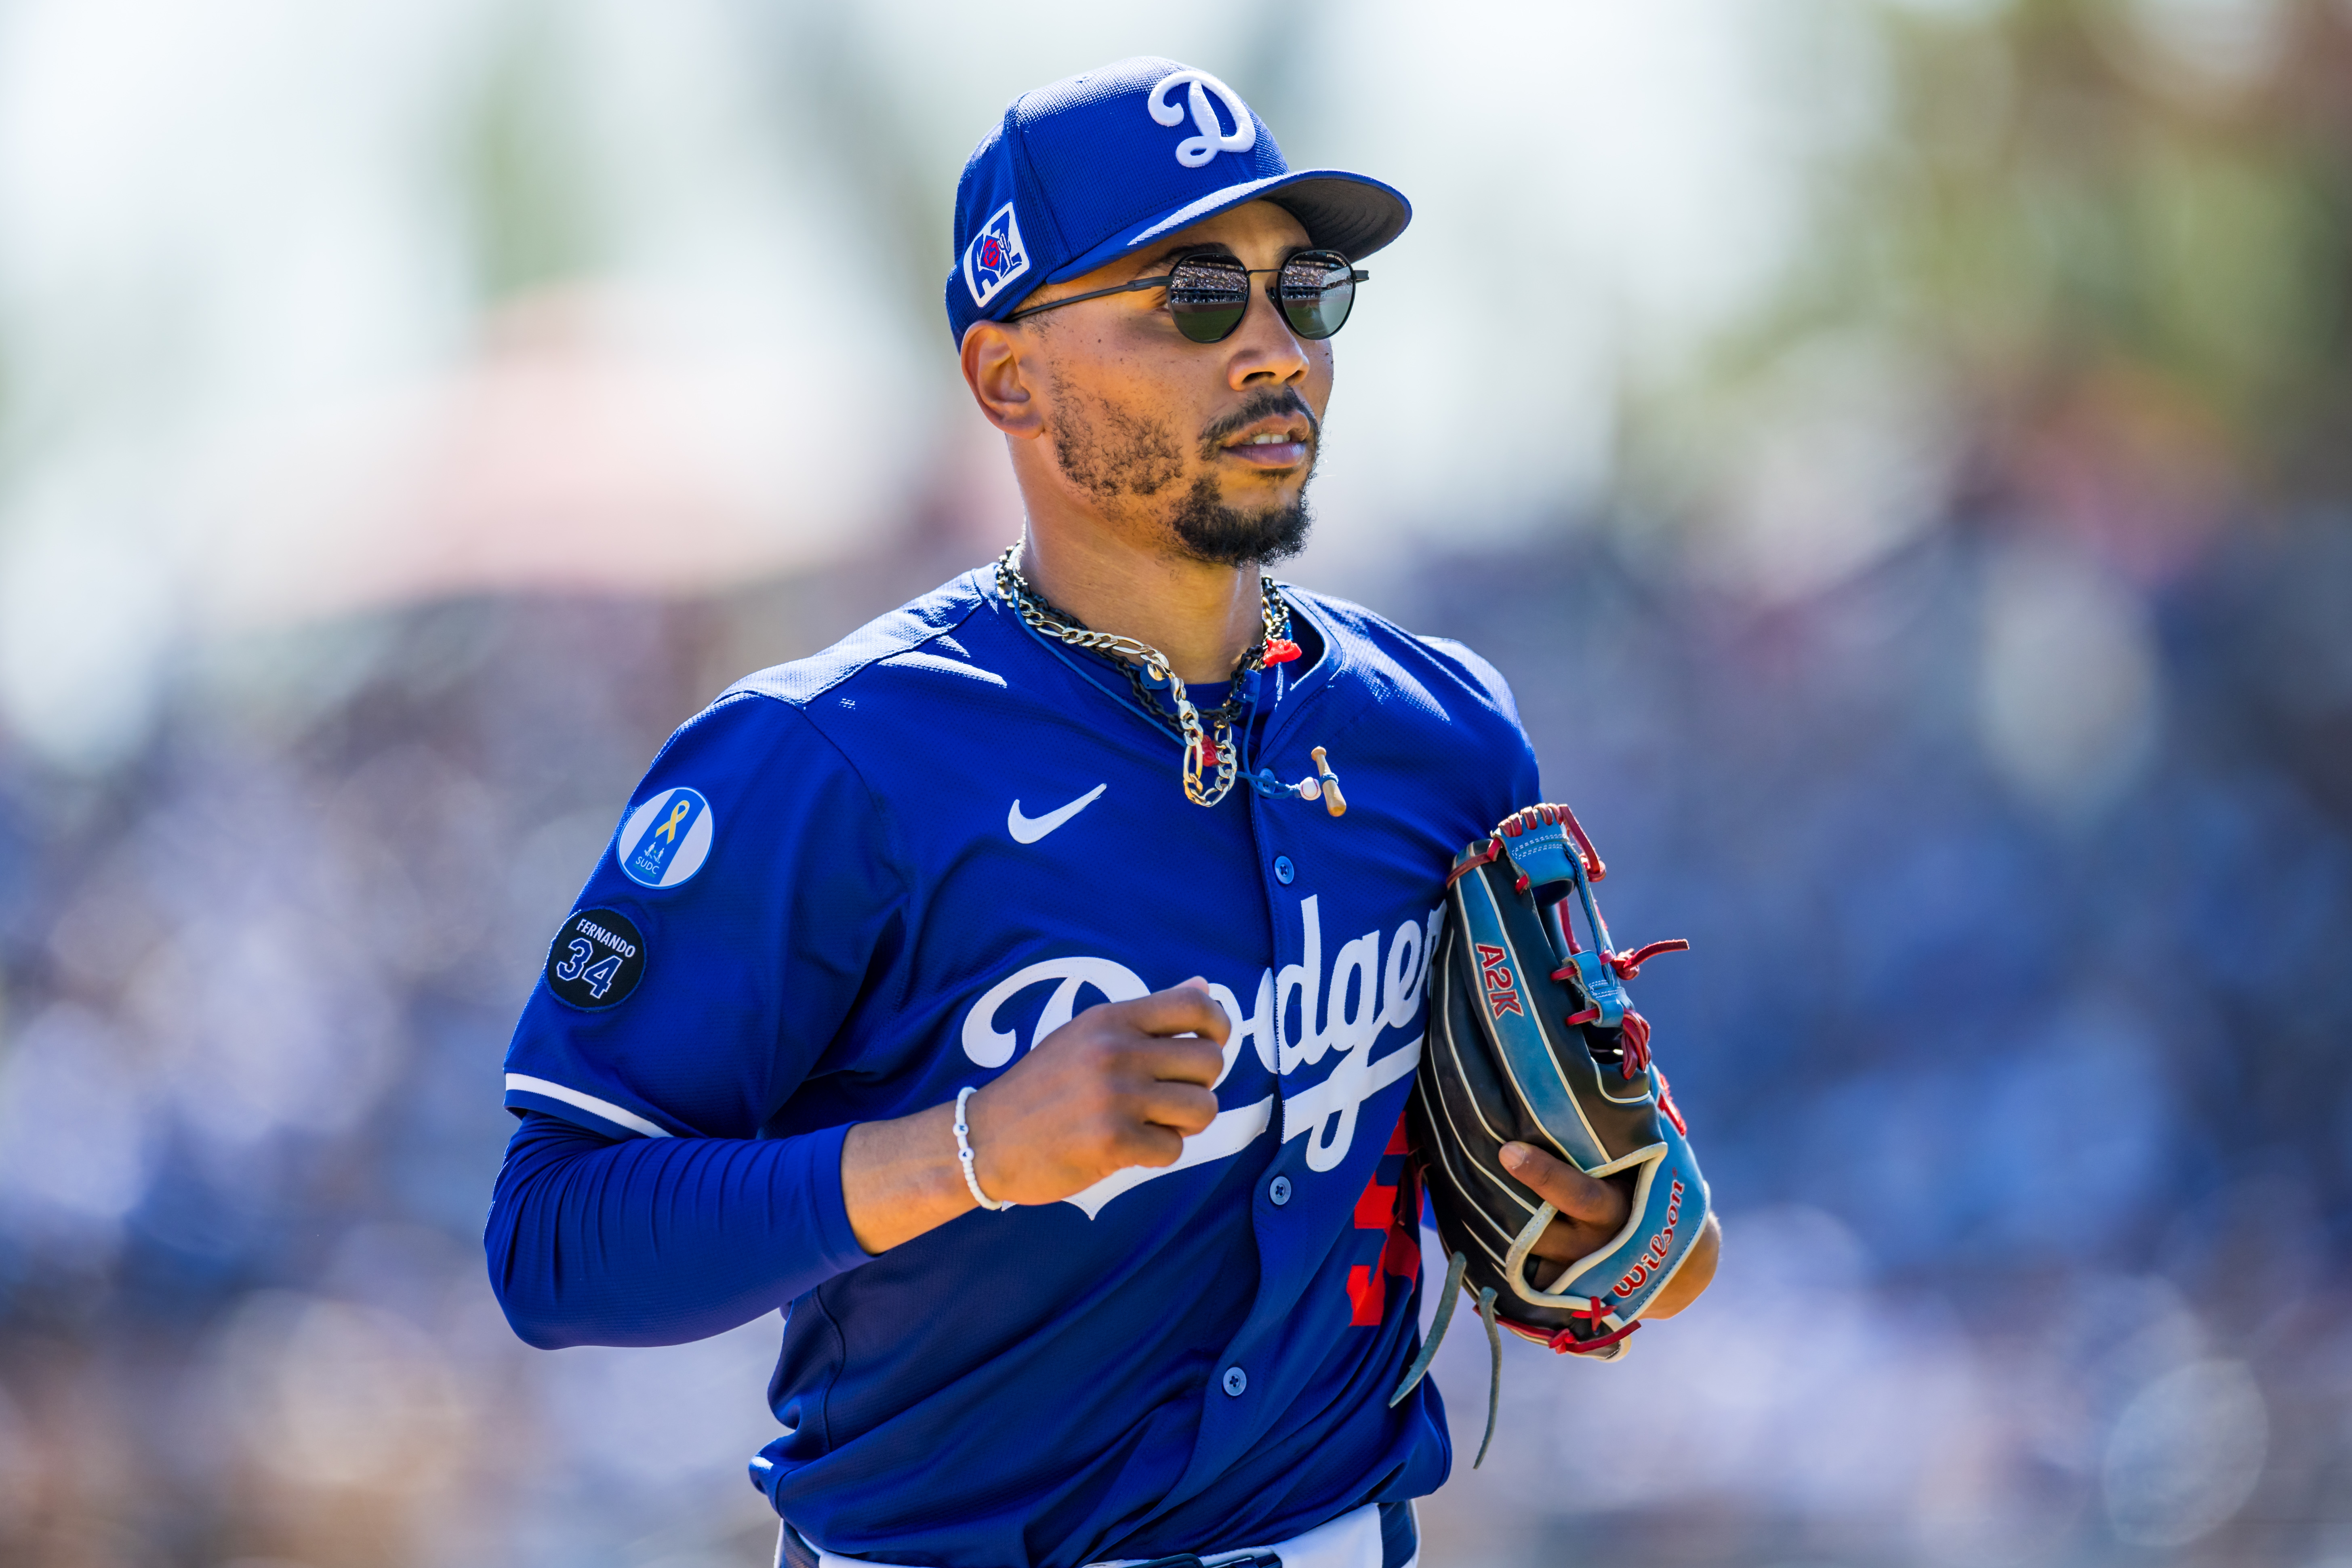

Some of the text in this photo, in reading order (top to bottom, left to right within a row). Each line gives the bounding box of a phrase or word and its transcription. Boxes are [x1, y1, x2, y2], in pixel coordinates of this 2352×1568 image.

[1148, 70, 1256, 168] D
[635, 856, 660, 874] SUDC
[556, 937, 623, 999] 34
[576, 918, 636, 958] FERNANDO
[1475, 943, 1525, 1021] A2K
[1612, 1179, 1685, 1298] Wilson
